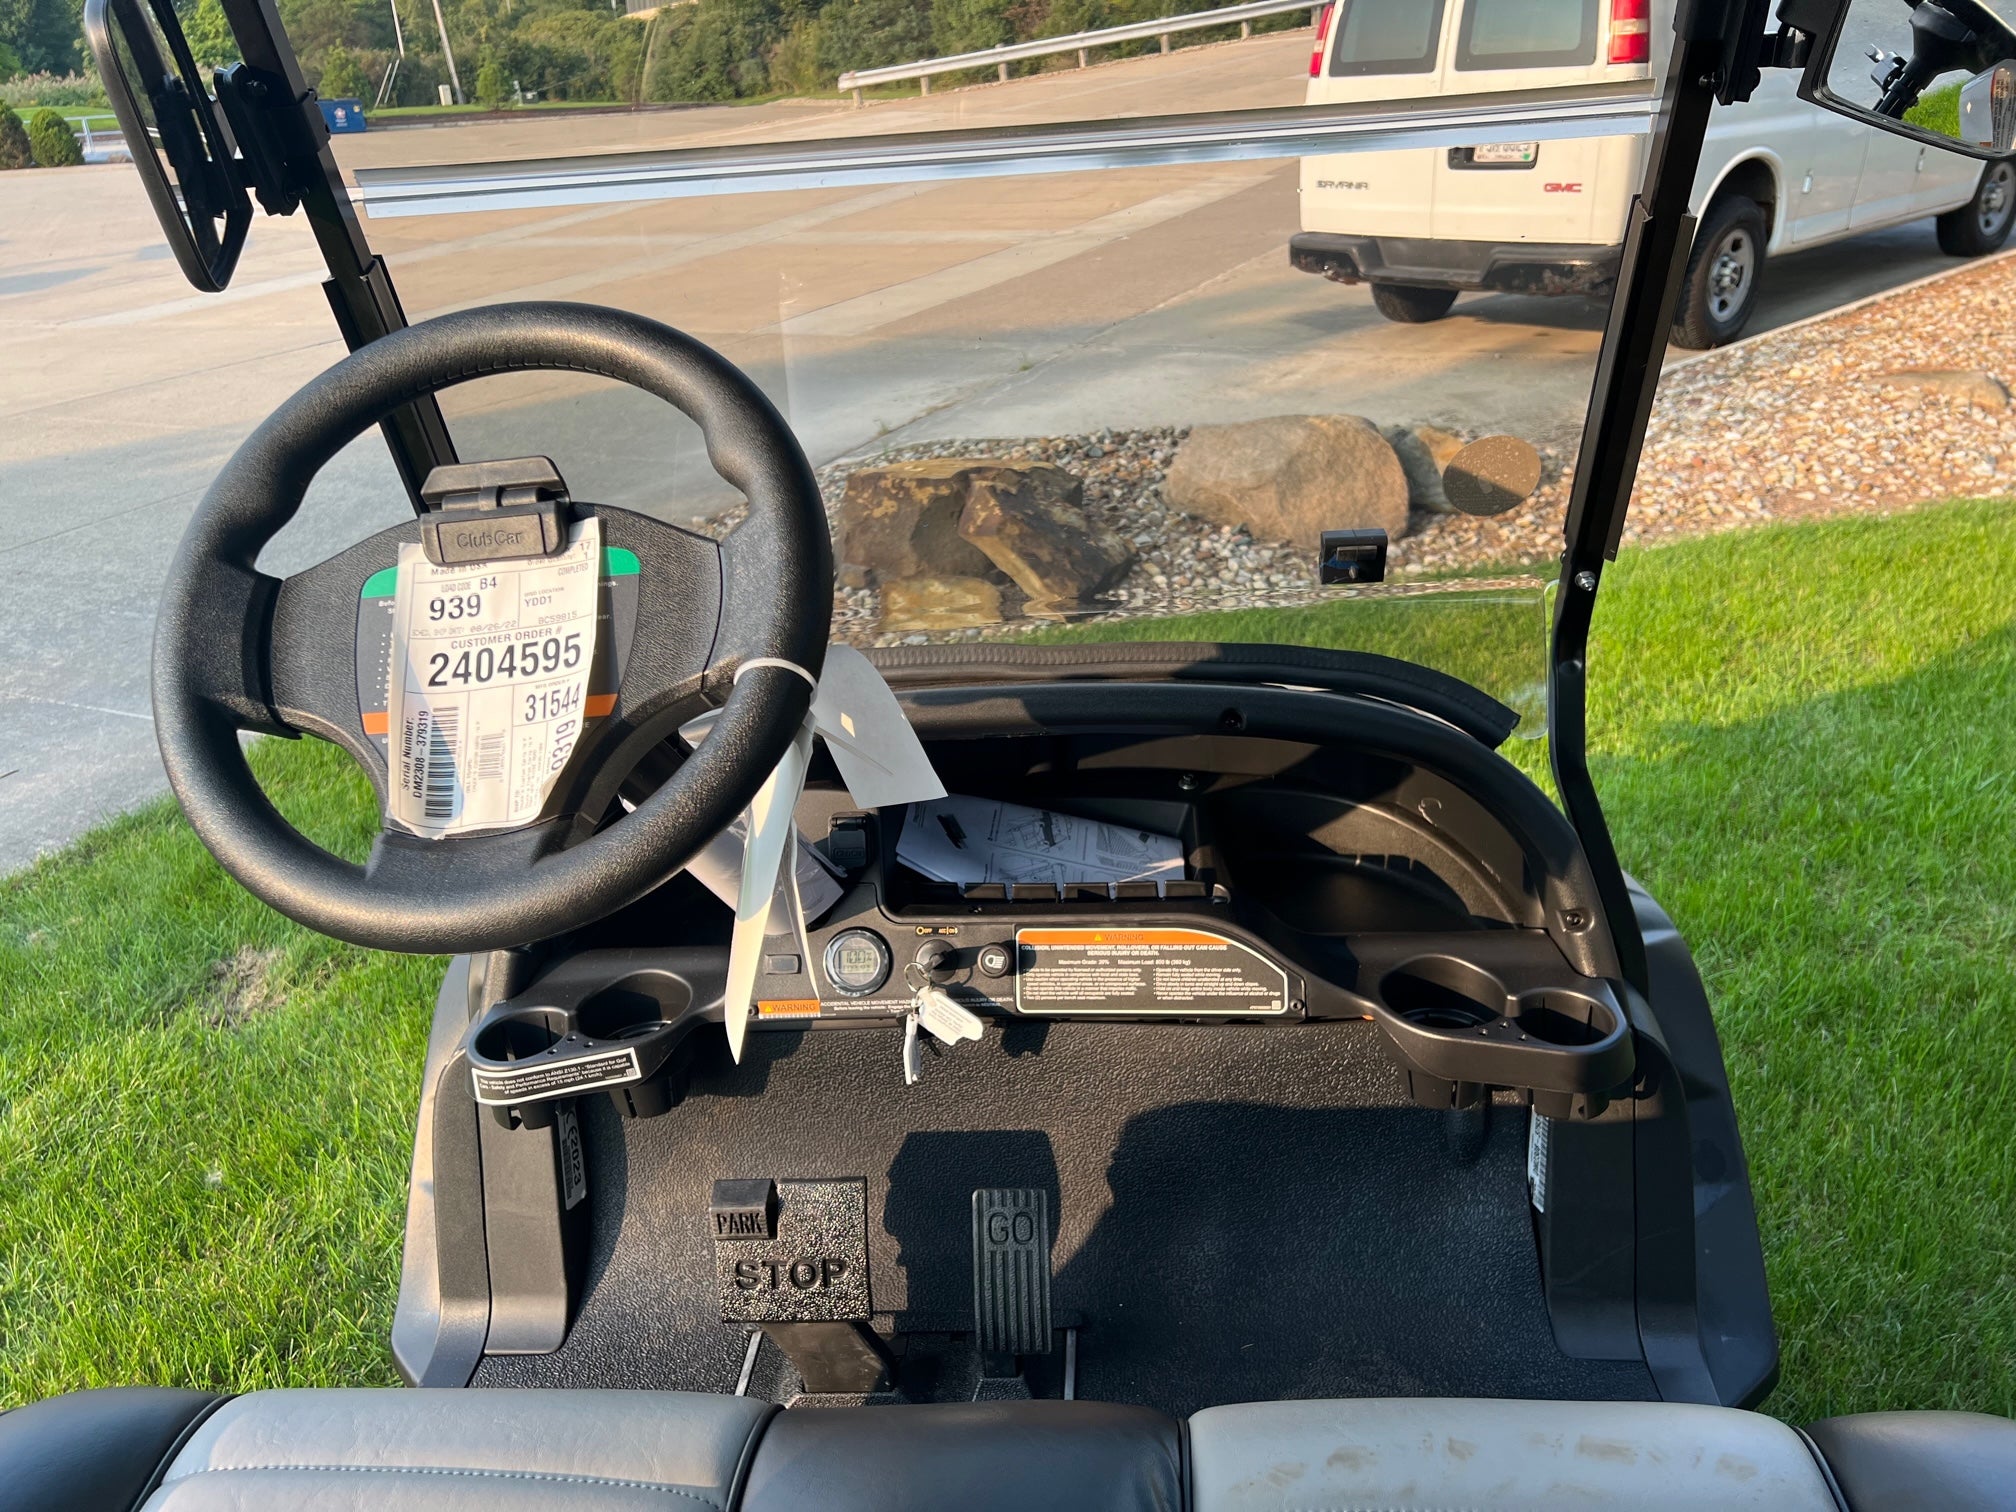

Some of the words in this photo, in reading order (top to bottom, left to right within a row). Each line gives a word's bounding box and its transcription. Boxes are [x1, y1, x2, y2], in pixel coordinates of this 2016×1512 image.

[1544, 183, 1582, 192] GMC
[456, 531, 493, 549] Club
[494, 529, 523, 546] Car
[580, 541, 591, 551] 17
[558, 563, 589, 576] COMPLETED
[480, 576, 497, 590] B4
[429, 592, 481, 621] 939
[524, 595, 552, 607] YDD1
[451, 633, 511, 650] CUSTOMER
[515, 628, 553, 642] ORDER
[428, 632, 581, 687] 2404595
[525, 682, 581, 722] 31544
[403, 716, 415, 759] Number:
[551, 718, 576, 771] 9319
[401, 761, 412, 791] Serial
[1104, 933, 1145, 941] WARNING
[772, 1002, 816, 1012] WARNING
[515, 1078, 546, 1088] Performance
[570, 1138, 582, 1187] 2023
[717, 1212, 763, 1235] PARK
[988, 1211, 1035, 1246] GO
[735, 1257, 848, 1291] STOP
